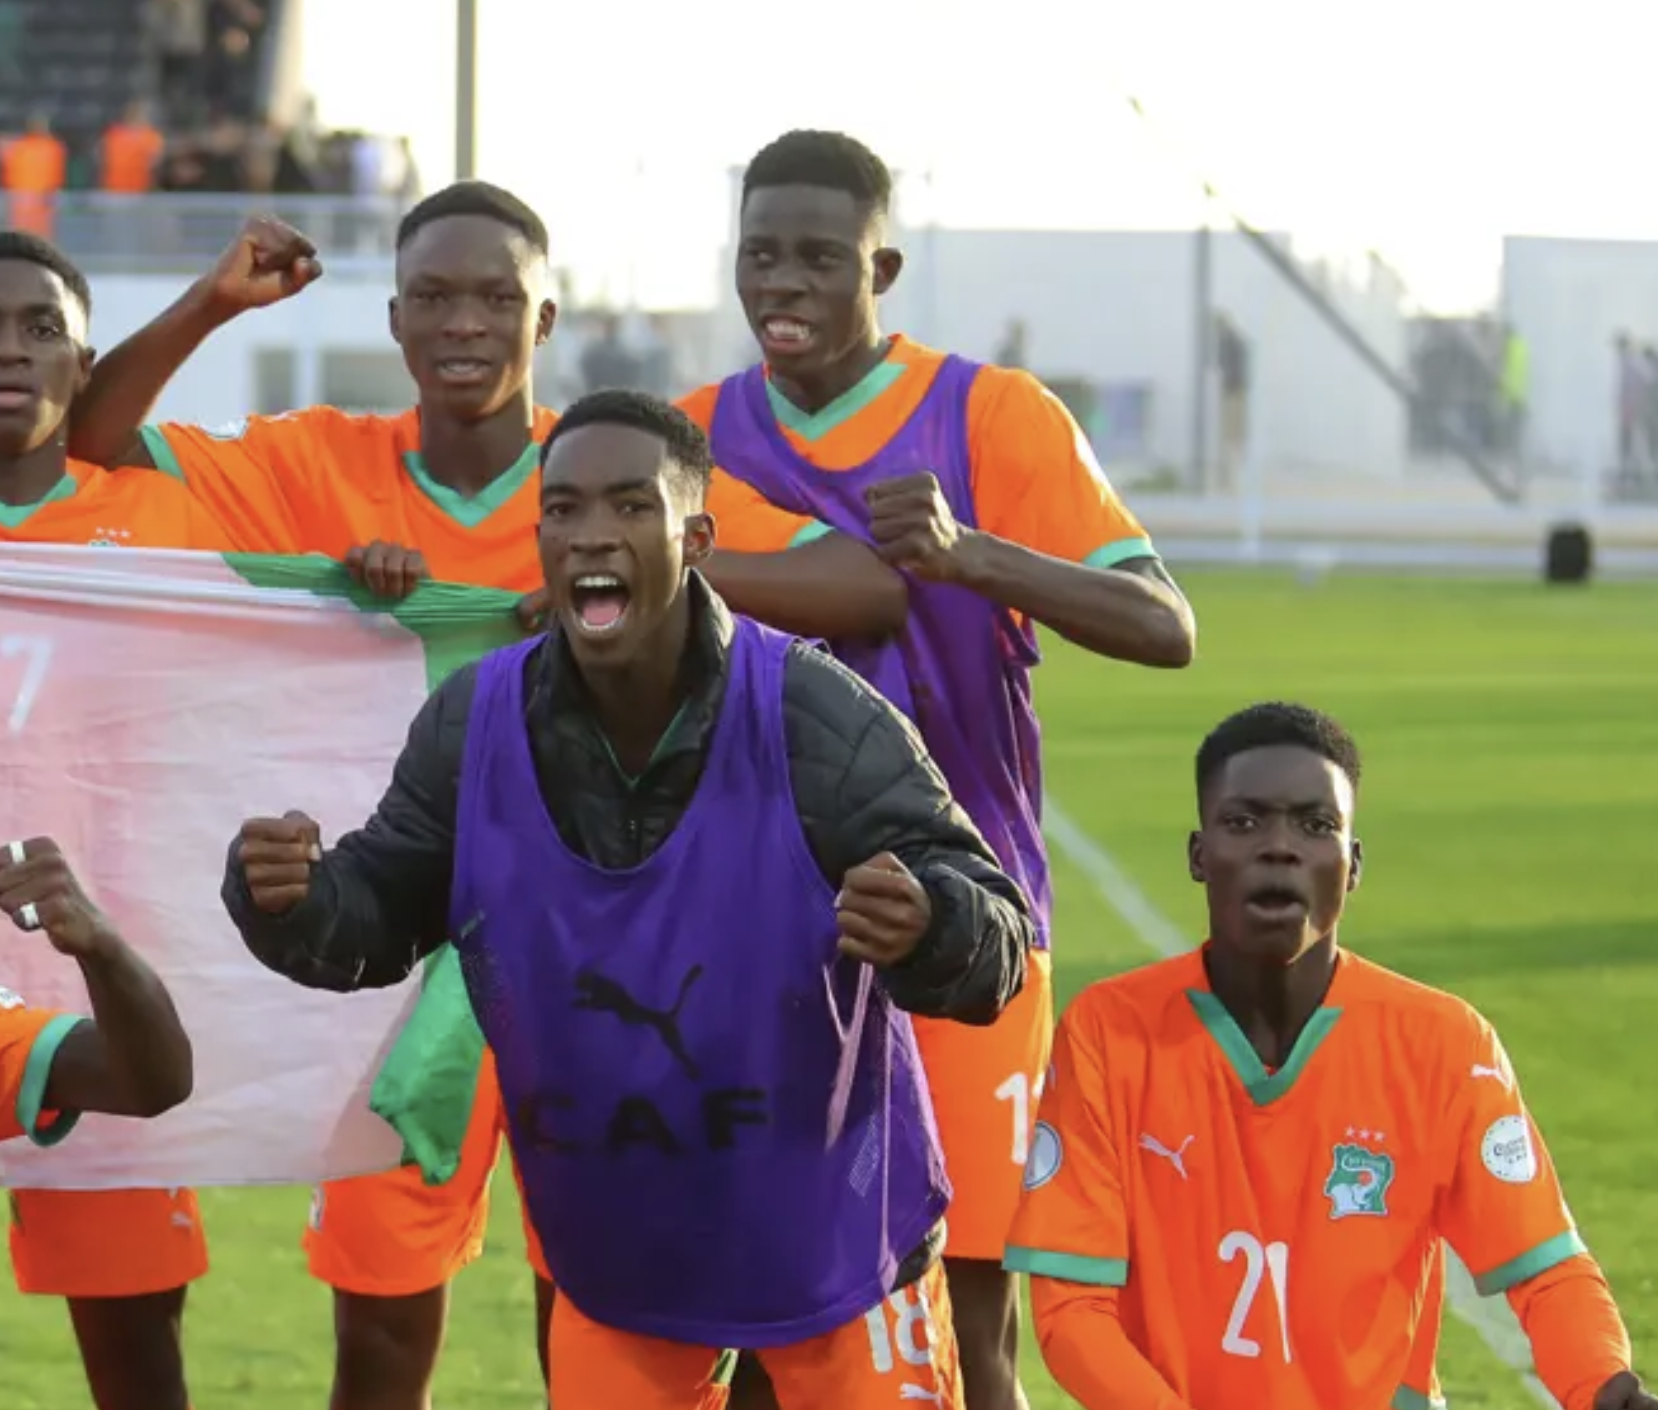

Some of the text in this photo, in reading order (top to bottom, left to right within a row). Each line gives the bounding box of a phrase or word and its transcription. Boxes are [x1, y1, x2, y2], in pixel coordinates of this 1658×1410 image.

[517, 1088, 772, 1156] CAF
[994, 1071, 1045, 1166] 1
[864, 1281, 939, 1374] 18
[1218, 1230, 1291, 1365] 21
